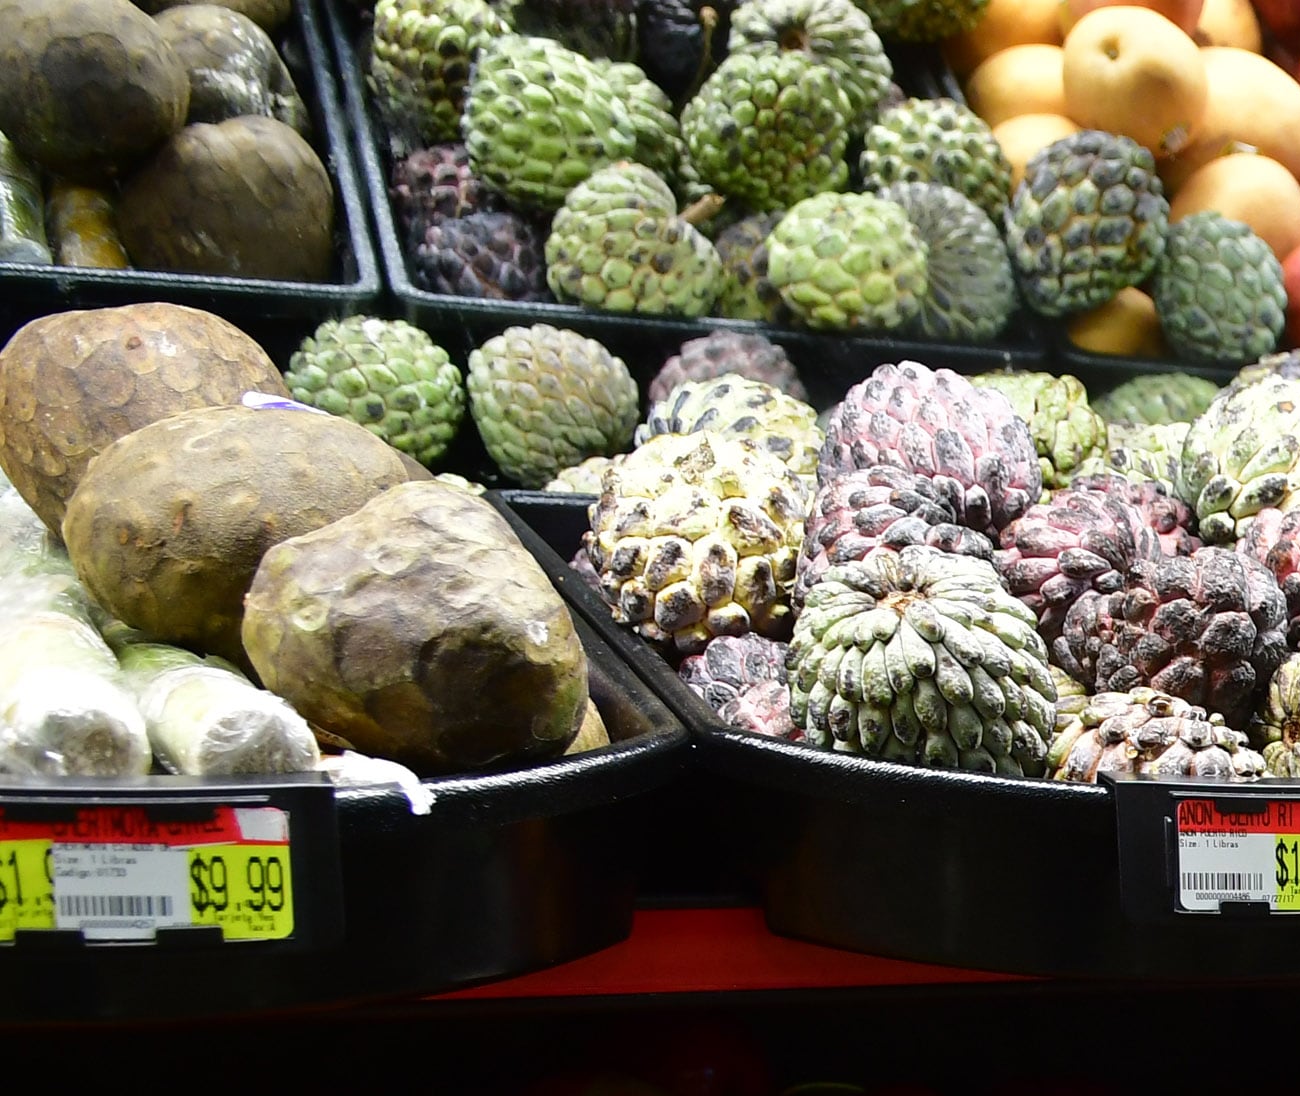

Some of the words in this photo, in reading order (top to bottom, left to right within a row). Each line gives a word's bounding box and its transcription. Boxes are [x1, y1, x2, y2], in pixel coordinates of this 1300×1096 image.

[1179, 800, 1213, 826] ANON
[1213, 839, 1239, 849] Libras
[190, 853, 285, 917] $9.99
